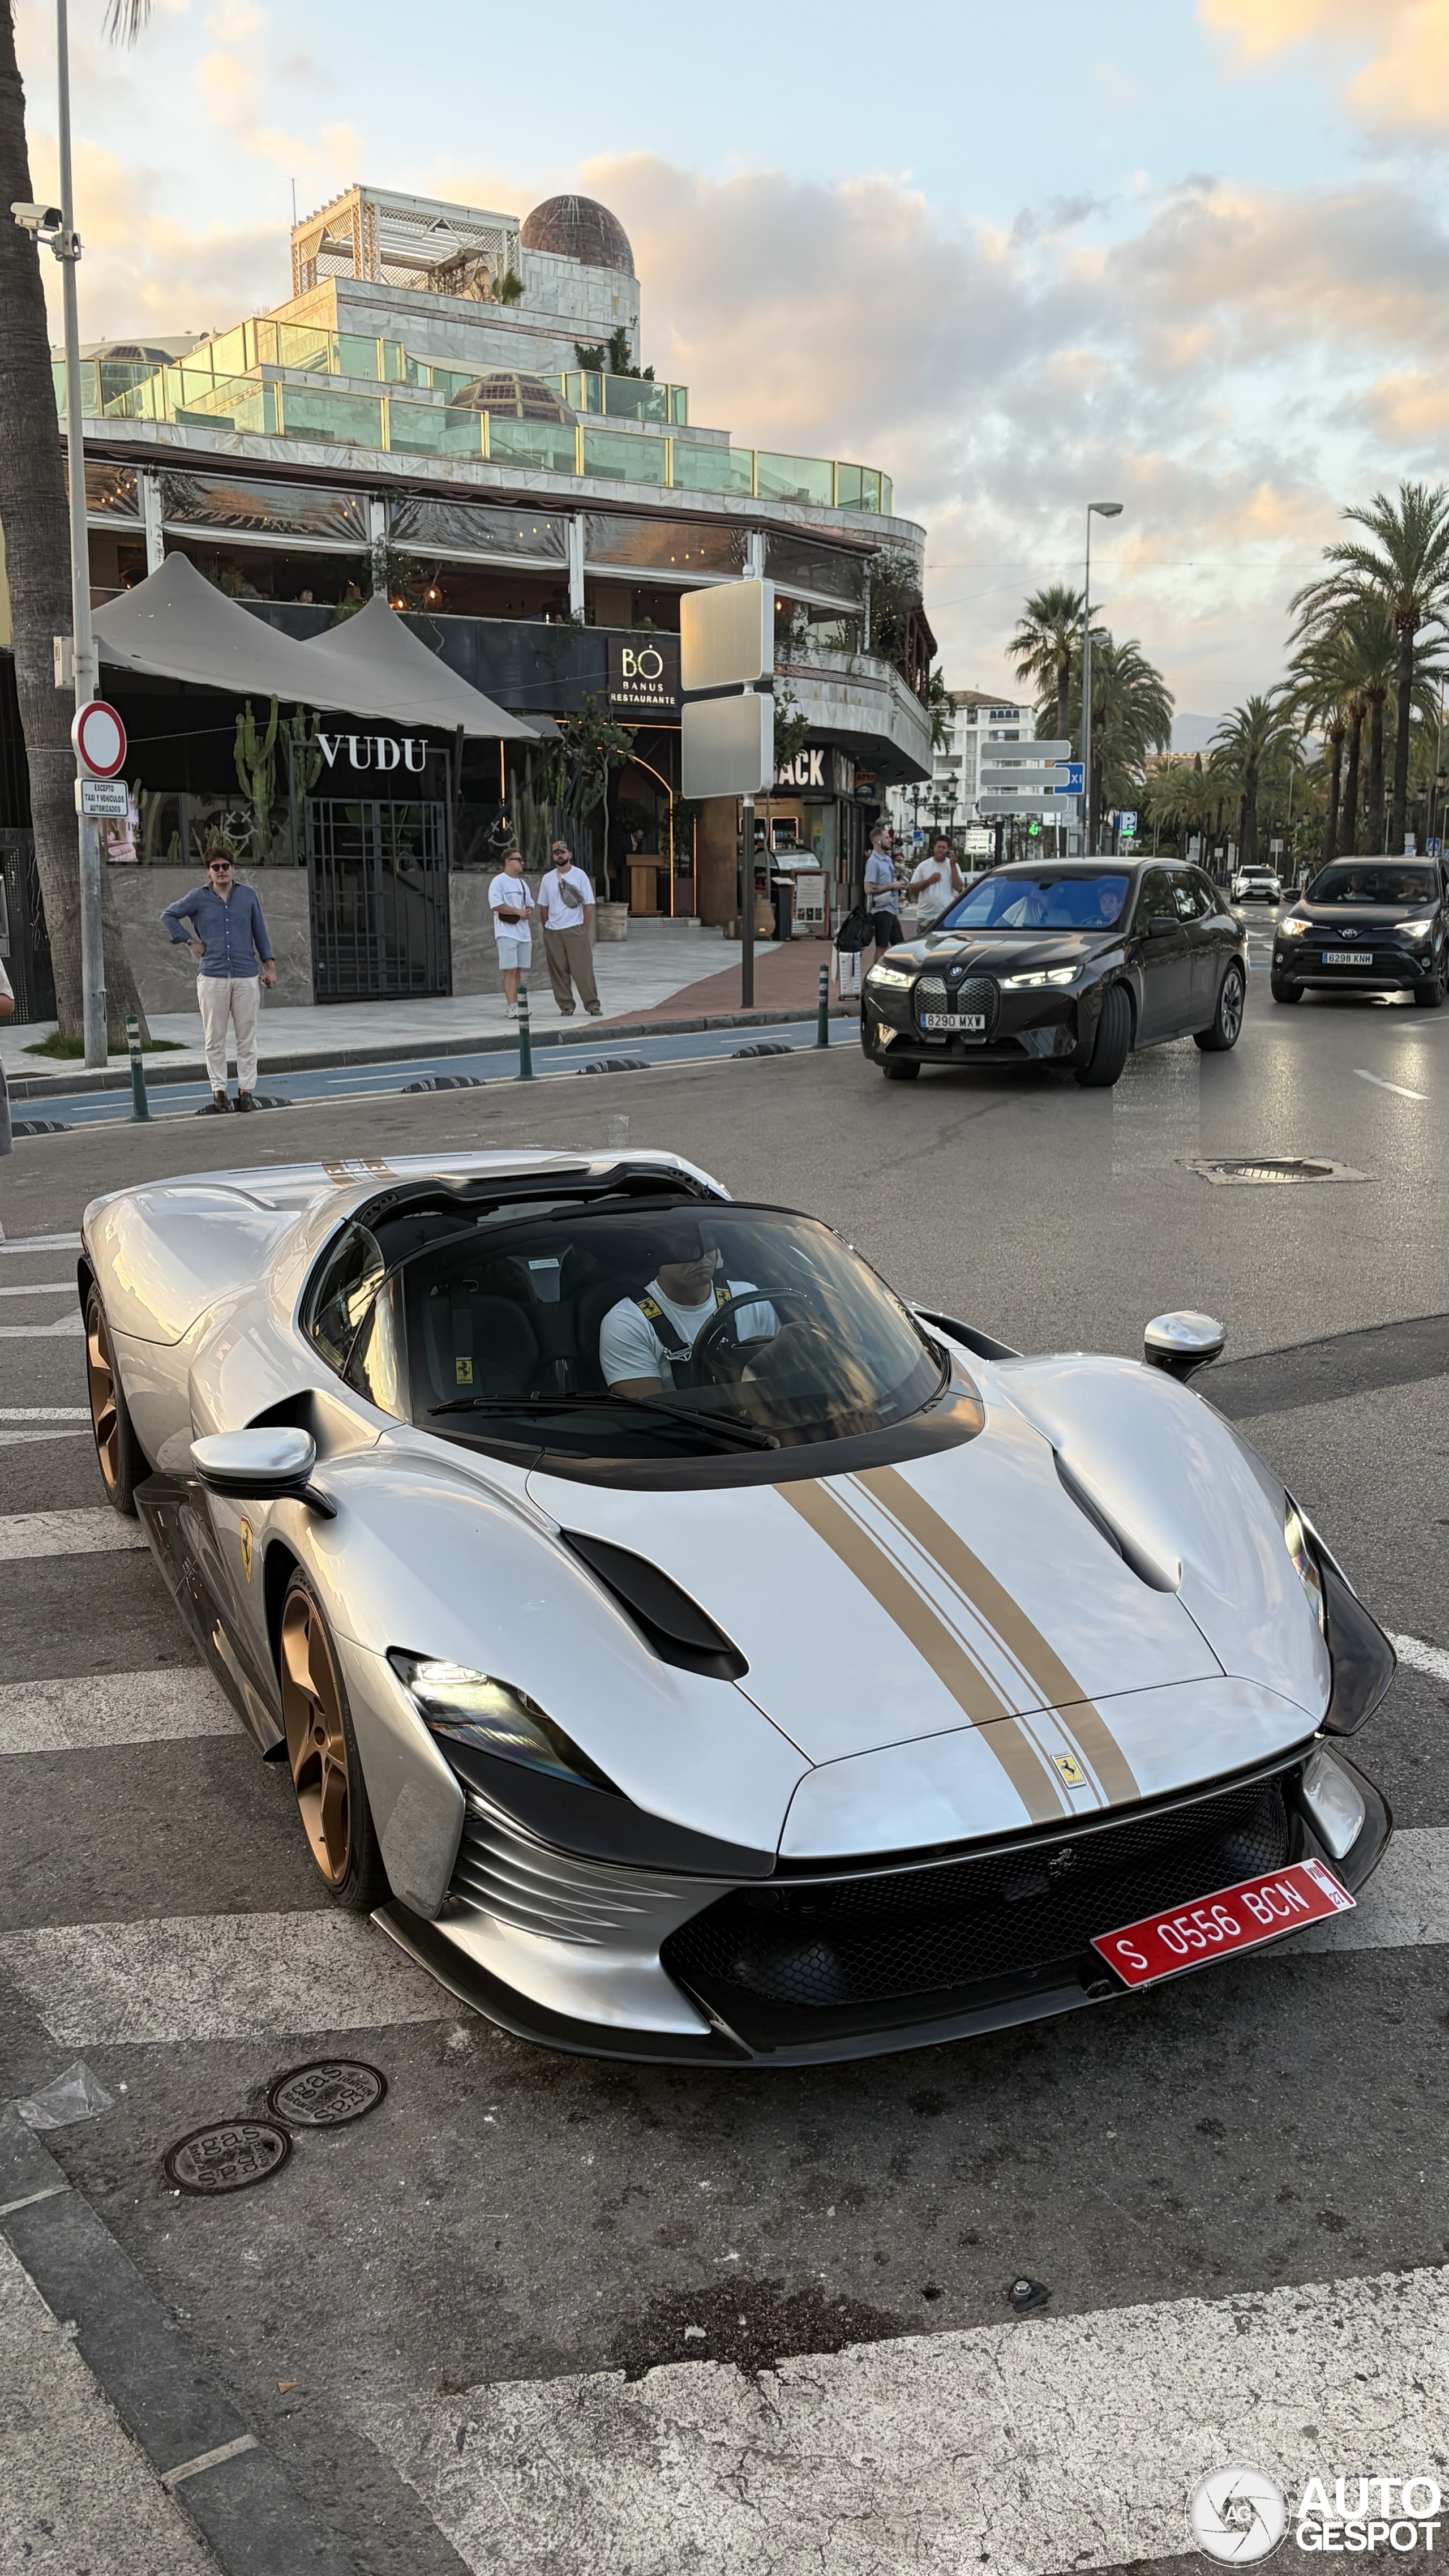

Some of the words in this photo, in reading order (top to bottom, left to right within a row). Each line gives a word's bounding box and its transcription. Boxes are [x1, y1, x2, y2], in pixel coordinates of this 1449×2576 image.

[611, 693, 676, 704] RESTAURANTE
[623, 681, 663, 692] BANUS
[315, 734, 428, 772] VUDU
[774, 749, 825, 786] ACK
[1070, 774, 1082, 783] XI
[90, 804, 121, 813] AUTORIZADOS
[928, 1015, 955, 1027] 8290
[959, 1015, 981, 1027] MXW
[1328, 1891, 1345, 1905] 27
[1116, 1940, 1148, 1969] S
[1157, 1905, 1241, 1954] 0556
[1240, 1880, 1310, 1925] BCN
[291, 2067, 341, 2099] gas
[336, 2076, 375, 2095] Natural
[281, 2091, 319, 2113] Natural
[314, 2089, 364, 2121] gas
[202, 2127, 260, 2155] gas
[187, 2144, 212, 2172] Natural
[199, 2155, 258, 2185] gas
